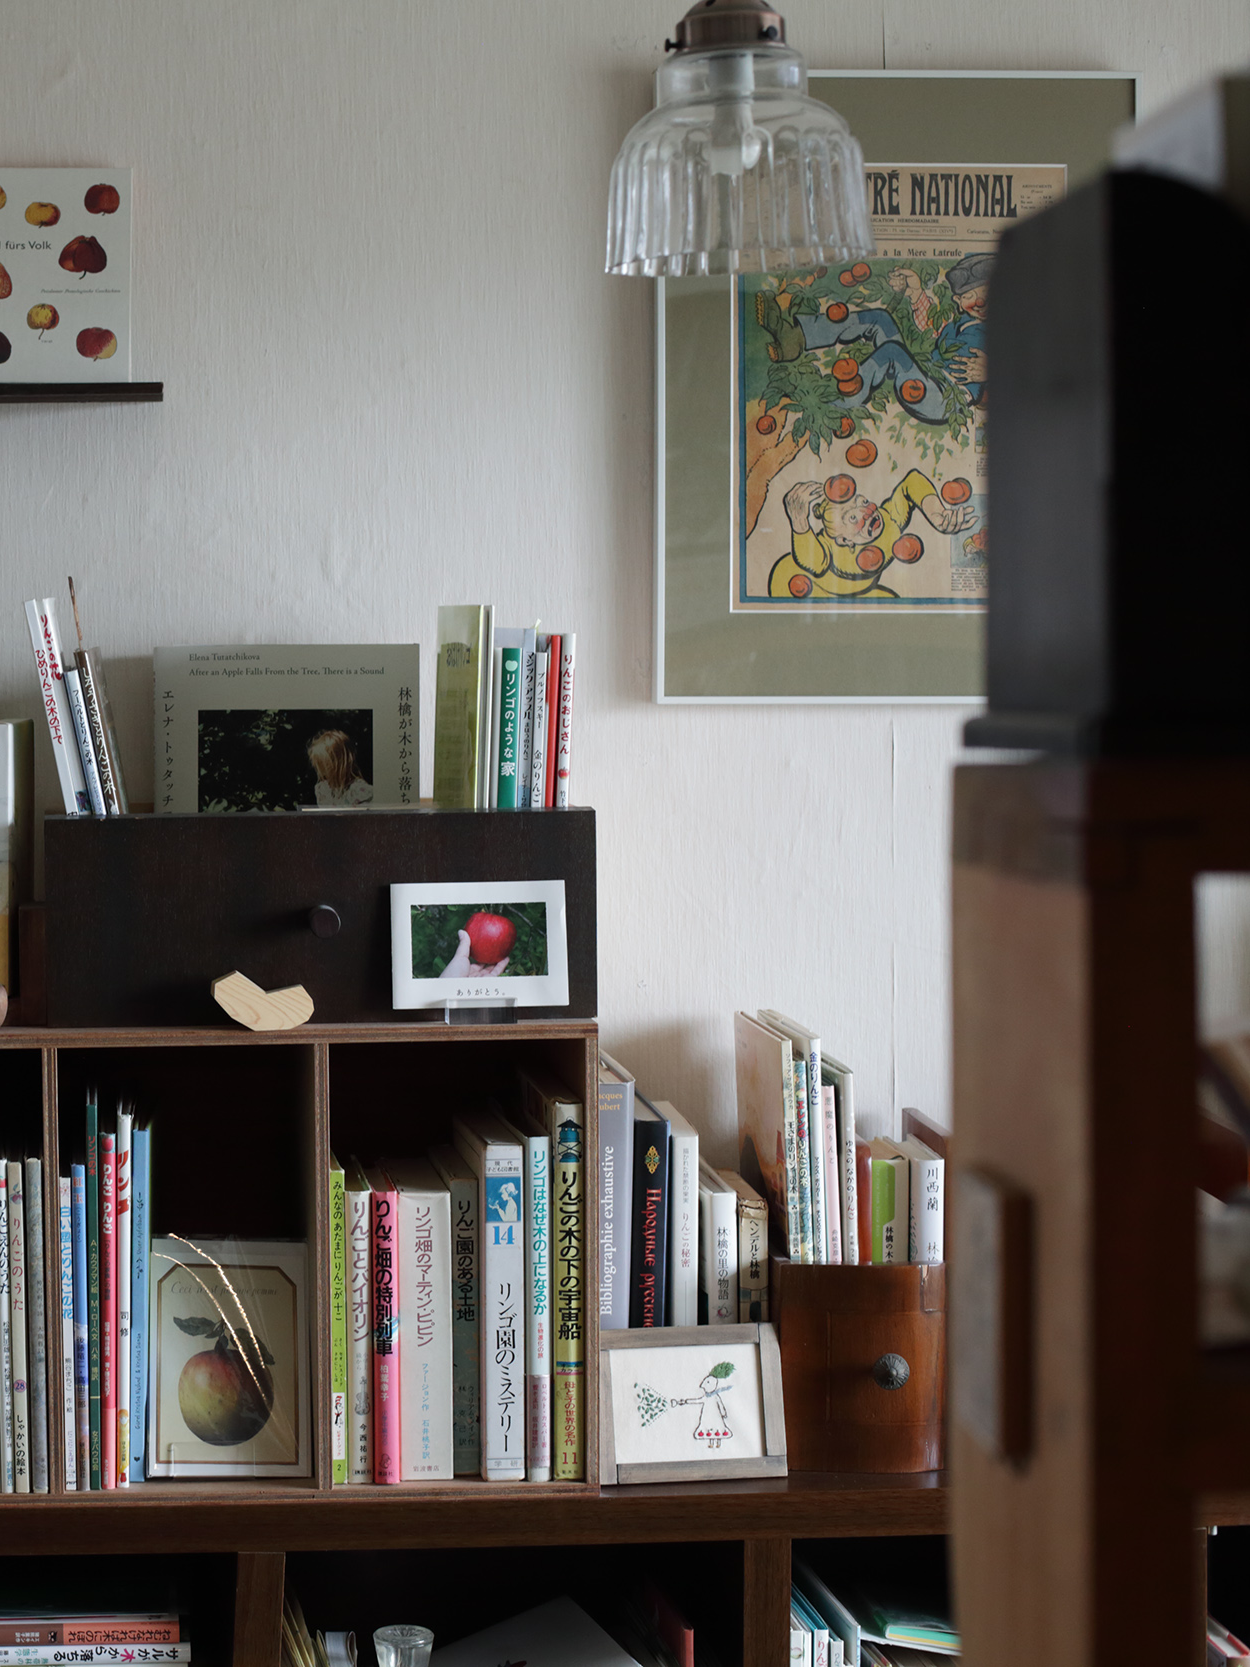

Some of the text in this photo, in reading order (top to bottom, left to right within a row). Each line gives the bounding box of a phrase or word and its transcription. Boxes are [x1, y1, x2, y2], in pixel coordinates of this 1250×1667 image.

[910, 172, 1017, 218] NATIONAL
[5, 240, 26, 250] fürs
[28, 240, 52, 250] Volk
[893, 248, 901, 256] la
[907, 248, 927, 256] Mère
[933, 248, 962, 257] Latrufe
[40, 613, 64, 682] りんごの花
[188, 667, 209, 677] After
[221, 667, 244, 678] Apple
[245, 667, 263, 676] Falls
[264, 667, 285, 676] From
[286, 667, 299, 676] the
[322, 667, 344, 676] There
[346, 667, 352, 676] is
[359, 666, 385, 676] Sound
[189, 653, 260, 661] Elena Tutatchikova
[35, 649, 64, 746] ひめりんごの木の下で
[500, 673, 516, 777] リンゴのような家
[559, 654, 573, 755] りんごのおじさん
[162, 690, 175, 814] エレナ・トゥタッチ
[397, 686, 413, 806] 林檎が木から落ち
[532, 749, 543, 803] 金のりんご
[808, 1051, 819, 1107] 金のりんご
[87, 1135, 96, 1177] リンゴの木
[795, 1099, 808, 1187] エレンのりんごの木
[72, 1176, 83, 1204] 紅玉
[103, 1163, 112, 1197] りんご
[117, 1150, 129, 1216] リンゴ
[925, 1168, 939, 1211] 川西蘭
[103, 1200, 113, 1235] りんご
[492, 1225, 515, 1246] 14
[532, 1150, 548, 1316] リンゴはなぜ木の上になるか
[600, 1145, 617, 1316] Bibliographie exhaustive
[681, 1211, 691, 1268] りんごの秘密
[748, 1220, 760, 1279] ヘンデルと林檎
[11, 1217, 23, 1312] りんごのうた
[332, 1180, 344, 1322] みんなの あたまに りんごが 十こ
[350, 1200, 370, 1343] りんごとバイオリン
[414, 1205, 434, 1349] リンゴ畑のマーティン・ピピン
[455, 1200, 475, 1323] りんご園のある土地
[557, 1170, 582, 1342] りんごの木の下の宇宙船
[639, 1187, 662, 1327] Народные русские
[716, 1226, 731, 1301] 林檎の里の物語
[374, 1199, 394, 1401] りんご畑の特別列車 柏葉幸子
[15, 1382, 25, 1391] 28
[495, 1282, 519, 1454] リンゴ園のミステリー
[421, 1362, 430, 1459] ファージョン作 石井桃子訳
[564, 1380, 576, 1447] 母と子の世界の名作
[15, 1414, 26, 1476] しゃかいの絵本
[91, 1430, 99, 1471] 女子パウロ会
[412, 1464, 440, 1473] 岩波書店
[562, 1452, 578, 1465] 11
[53, 1645, 179, 1664] サルが木から落ちる
[68, 1629, 171, 1643] ねむれなければ木にのぼれ
